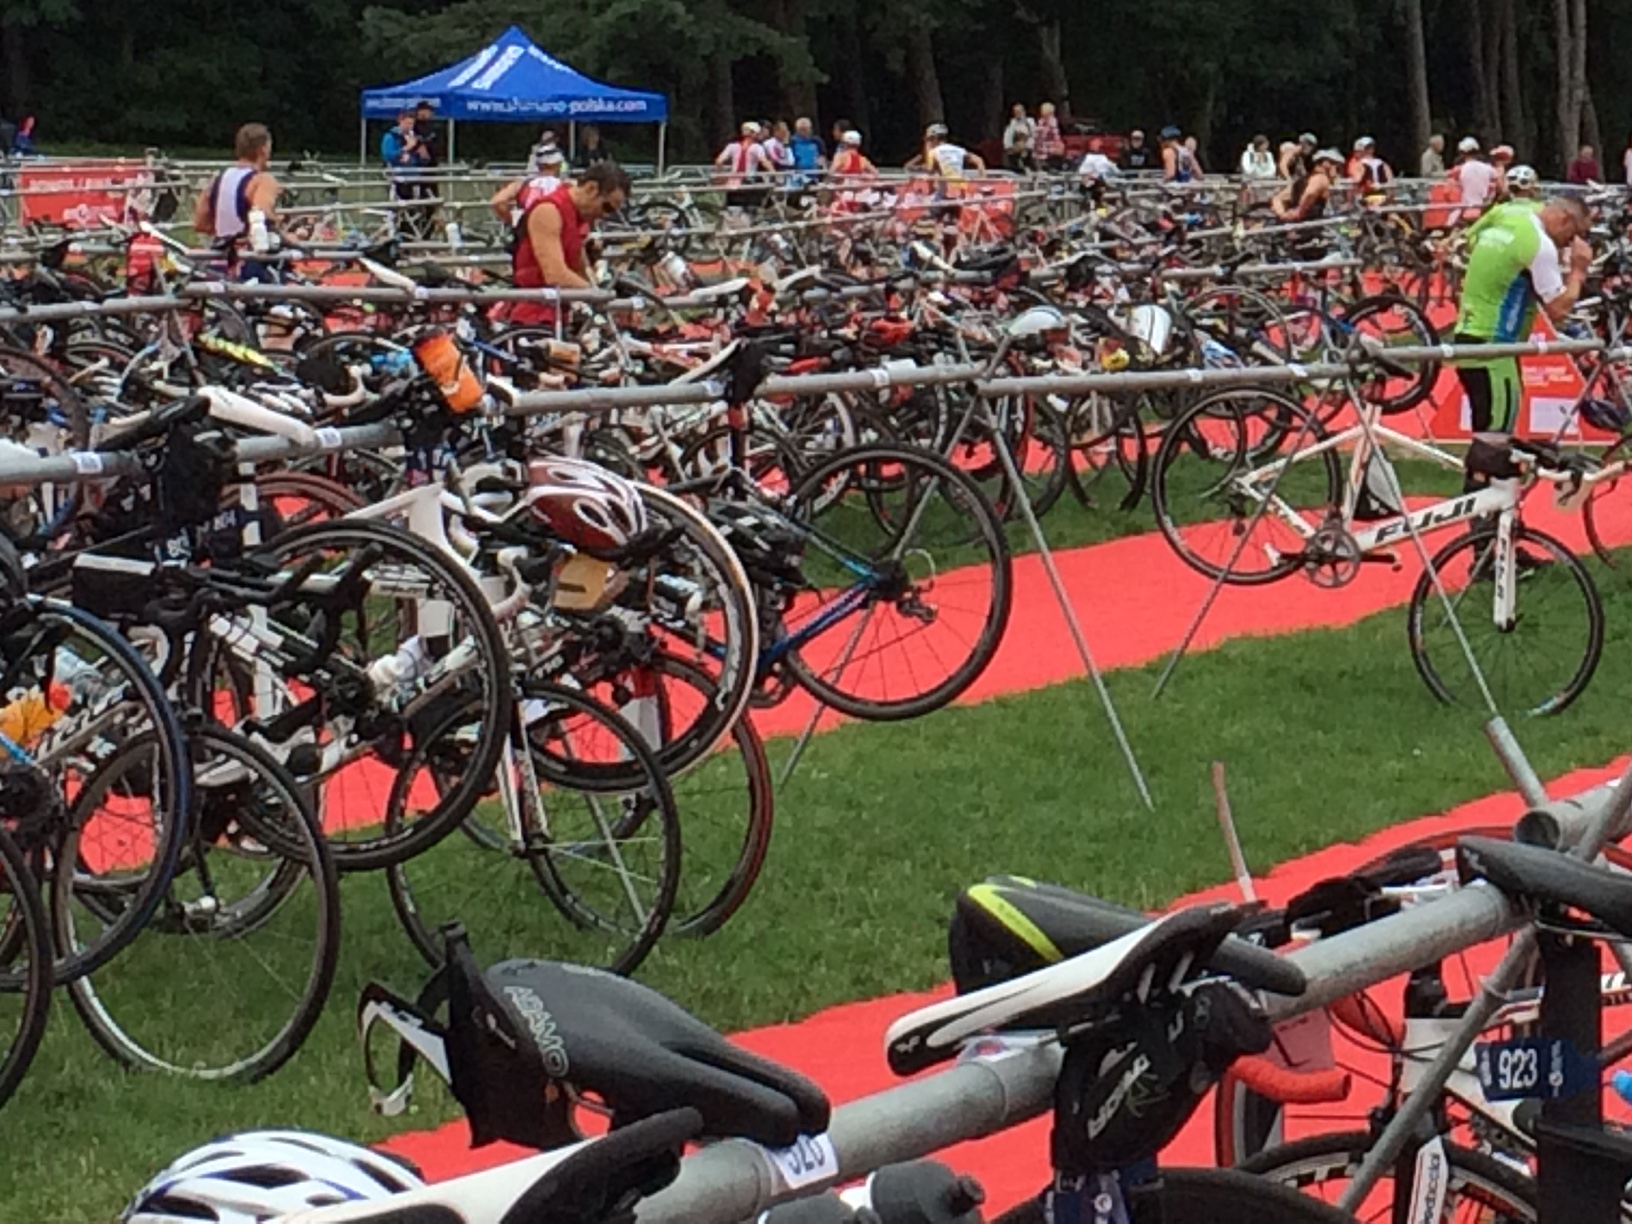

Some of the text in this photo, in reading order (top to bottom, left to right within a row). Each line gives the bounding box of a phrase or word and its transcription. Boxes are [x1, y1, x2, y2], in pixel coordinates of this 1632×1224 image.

[1374, 497, 1478, 544] FUJI
[503, 985, 570, 1078] ADAMO
[1498, 1047, 1538, 1090] 923
